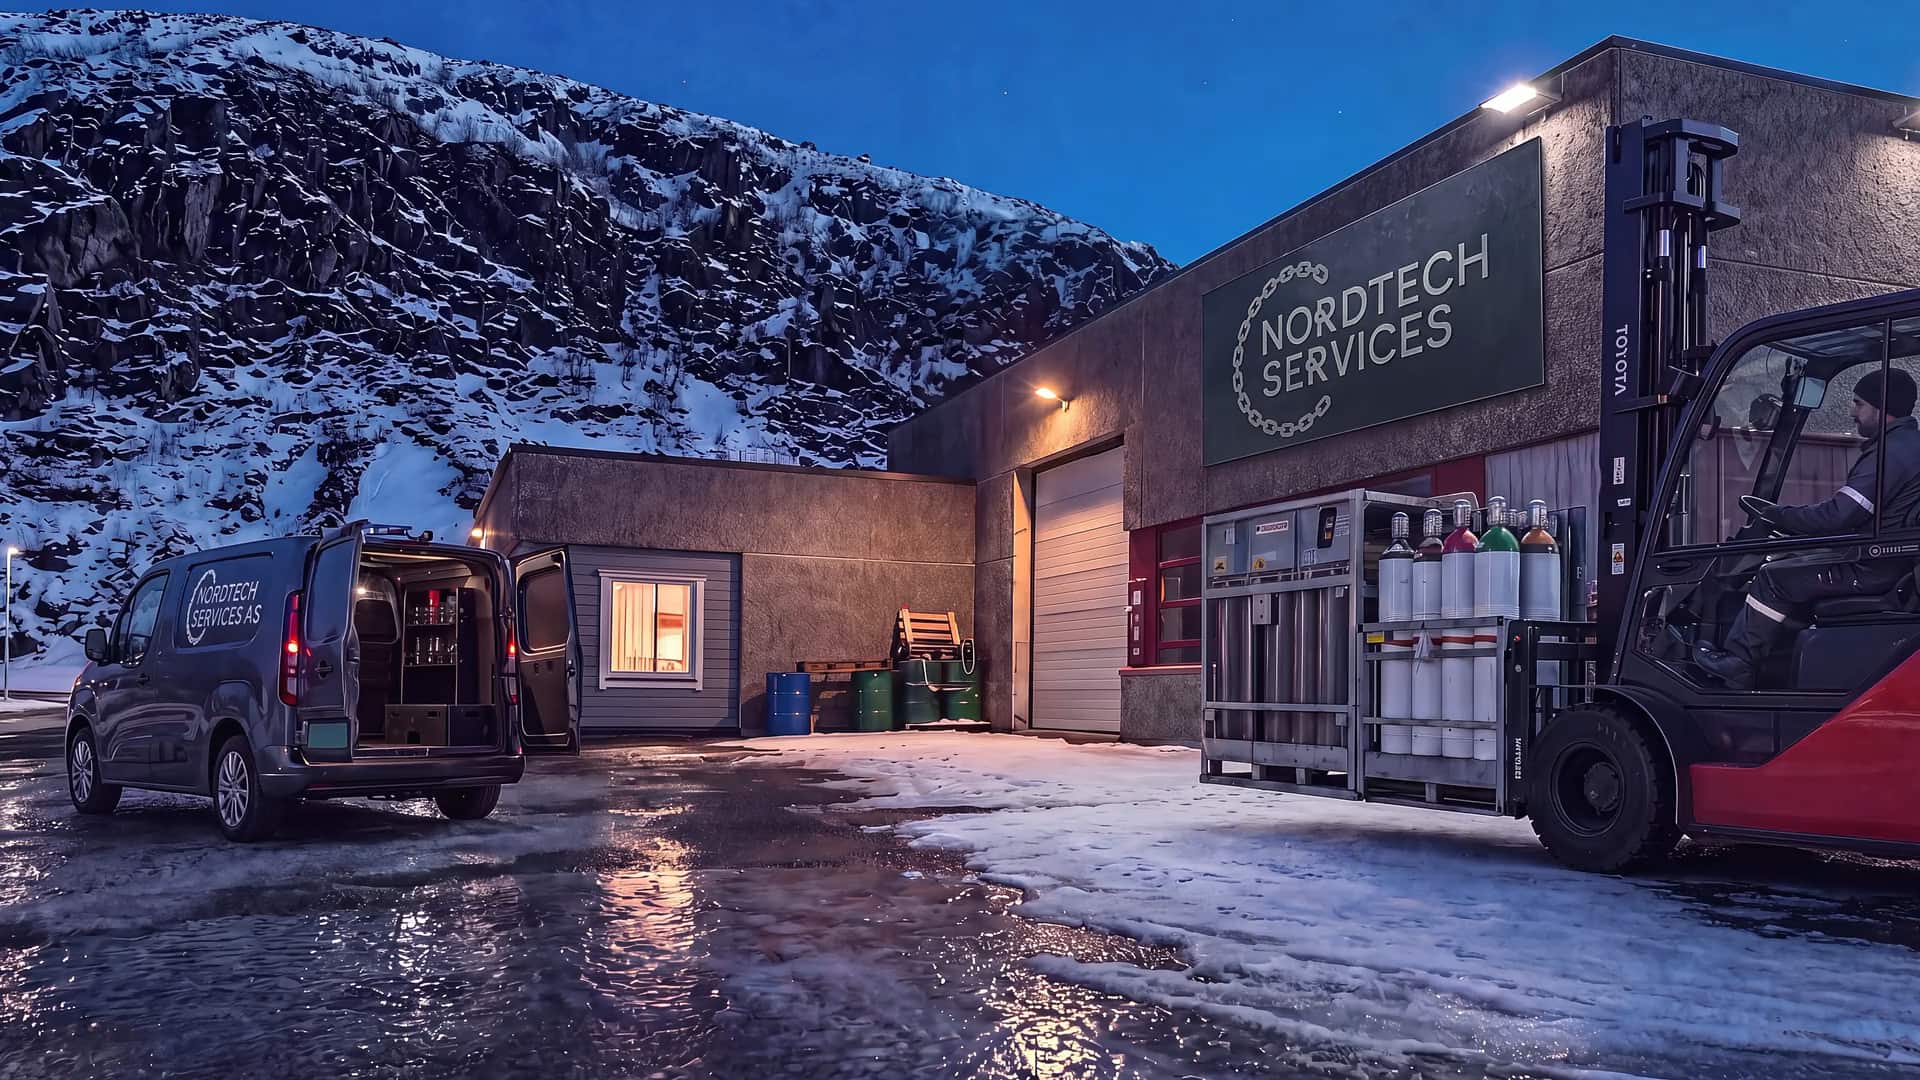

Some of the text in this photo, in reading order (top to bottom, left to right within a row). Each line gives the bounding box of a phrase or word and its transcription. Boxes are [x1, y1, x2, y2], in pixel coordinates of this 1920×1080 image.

[1262, 233, 1489, 356] NORDTECH
[1263, 303, 1452, 398] SERVICES
[1614, 323, 1629, 397] TOYOTA
[191, 604, 262, 628] SERVICES AS
[197, 580, 260, 605] NORDTECH
